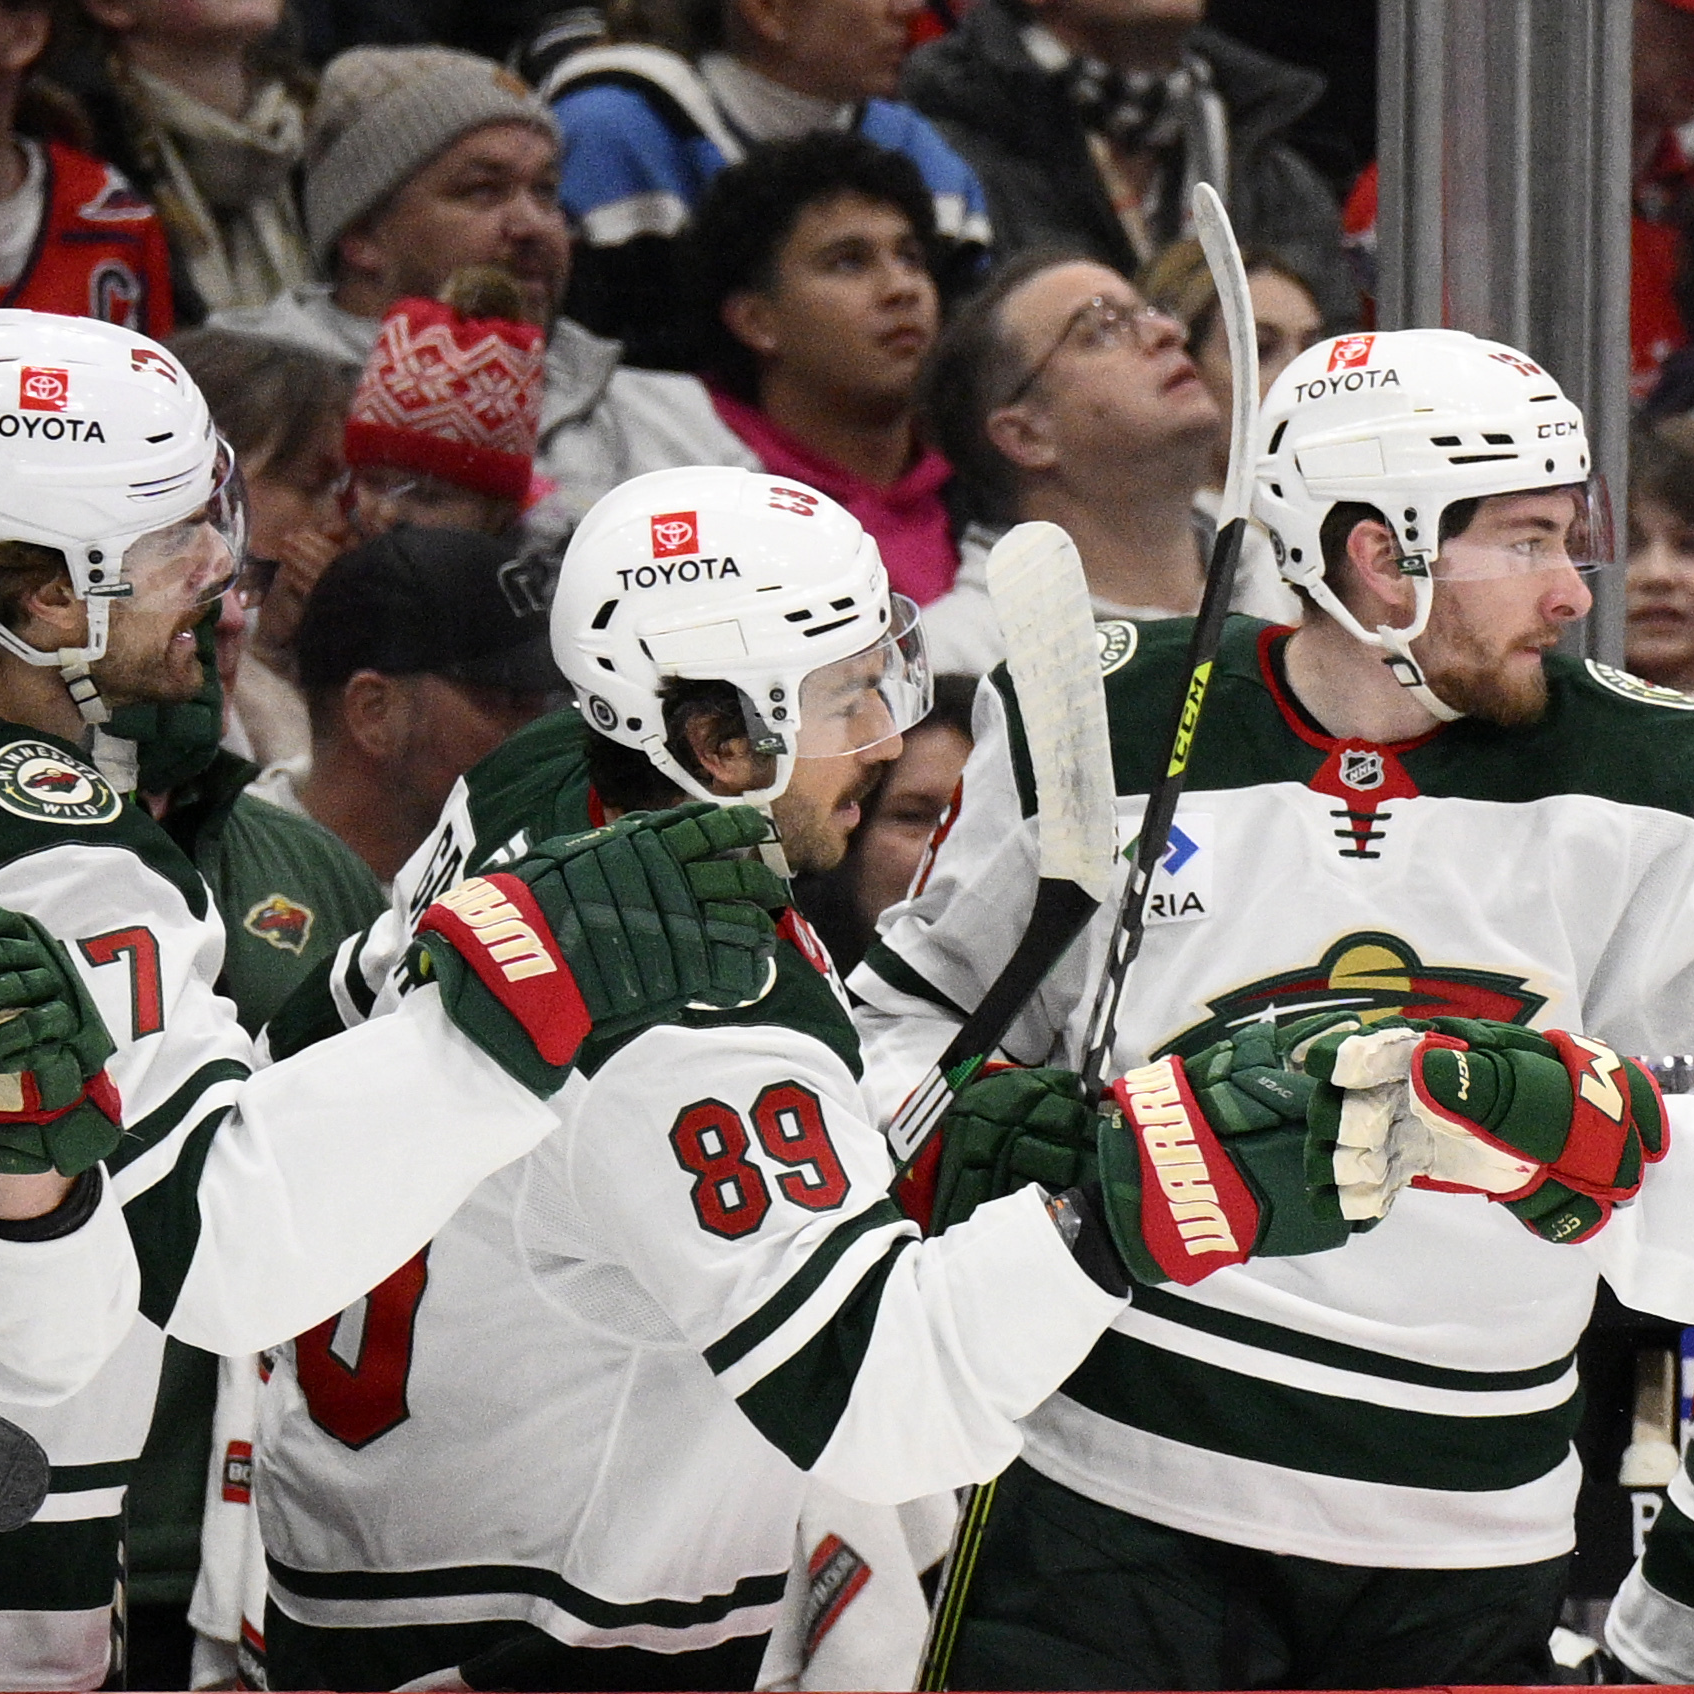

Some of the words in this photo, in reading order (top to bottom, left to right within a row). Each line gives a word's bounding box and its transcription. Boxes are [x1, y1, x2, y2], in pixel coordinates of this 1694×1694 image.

[1294, 368, 1400, 404] TOYOTA
[1537, 420, 1578, 439] CCM
[617, 557, 741, 591] TOYOTA
[1174, 676, 1204, 764] CCM
[1349, 762, 1379, 782] NHL
[42, 802, 99, 816] WILD
[63, 926, 165, 1040] 7
[669, 1080, 851, 1240] 89
